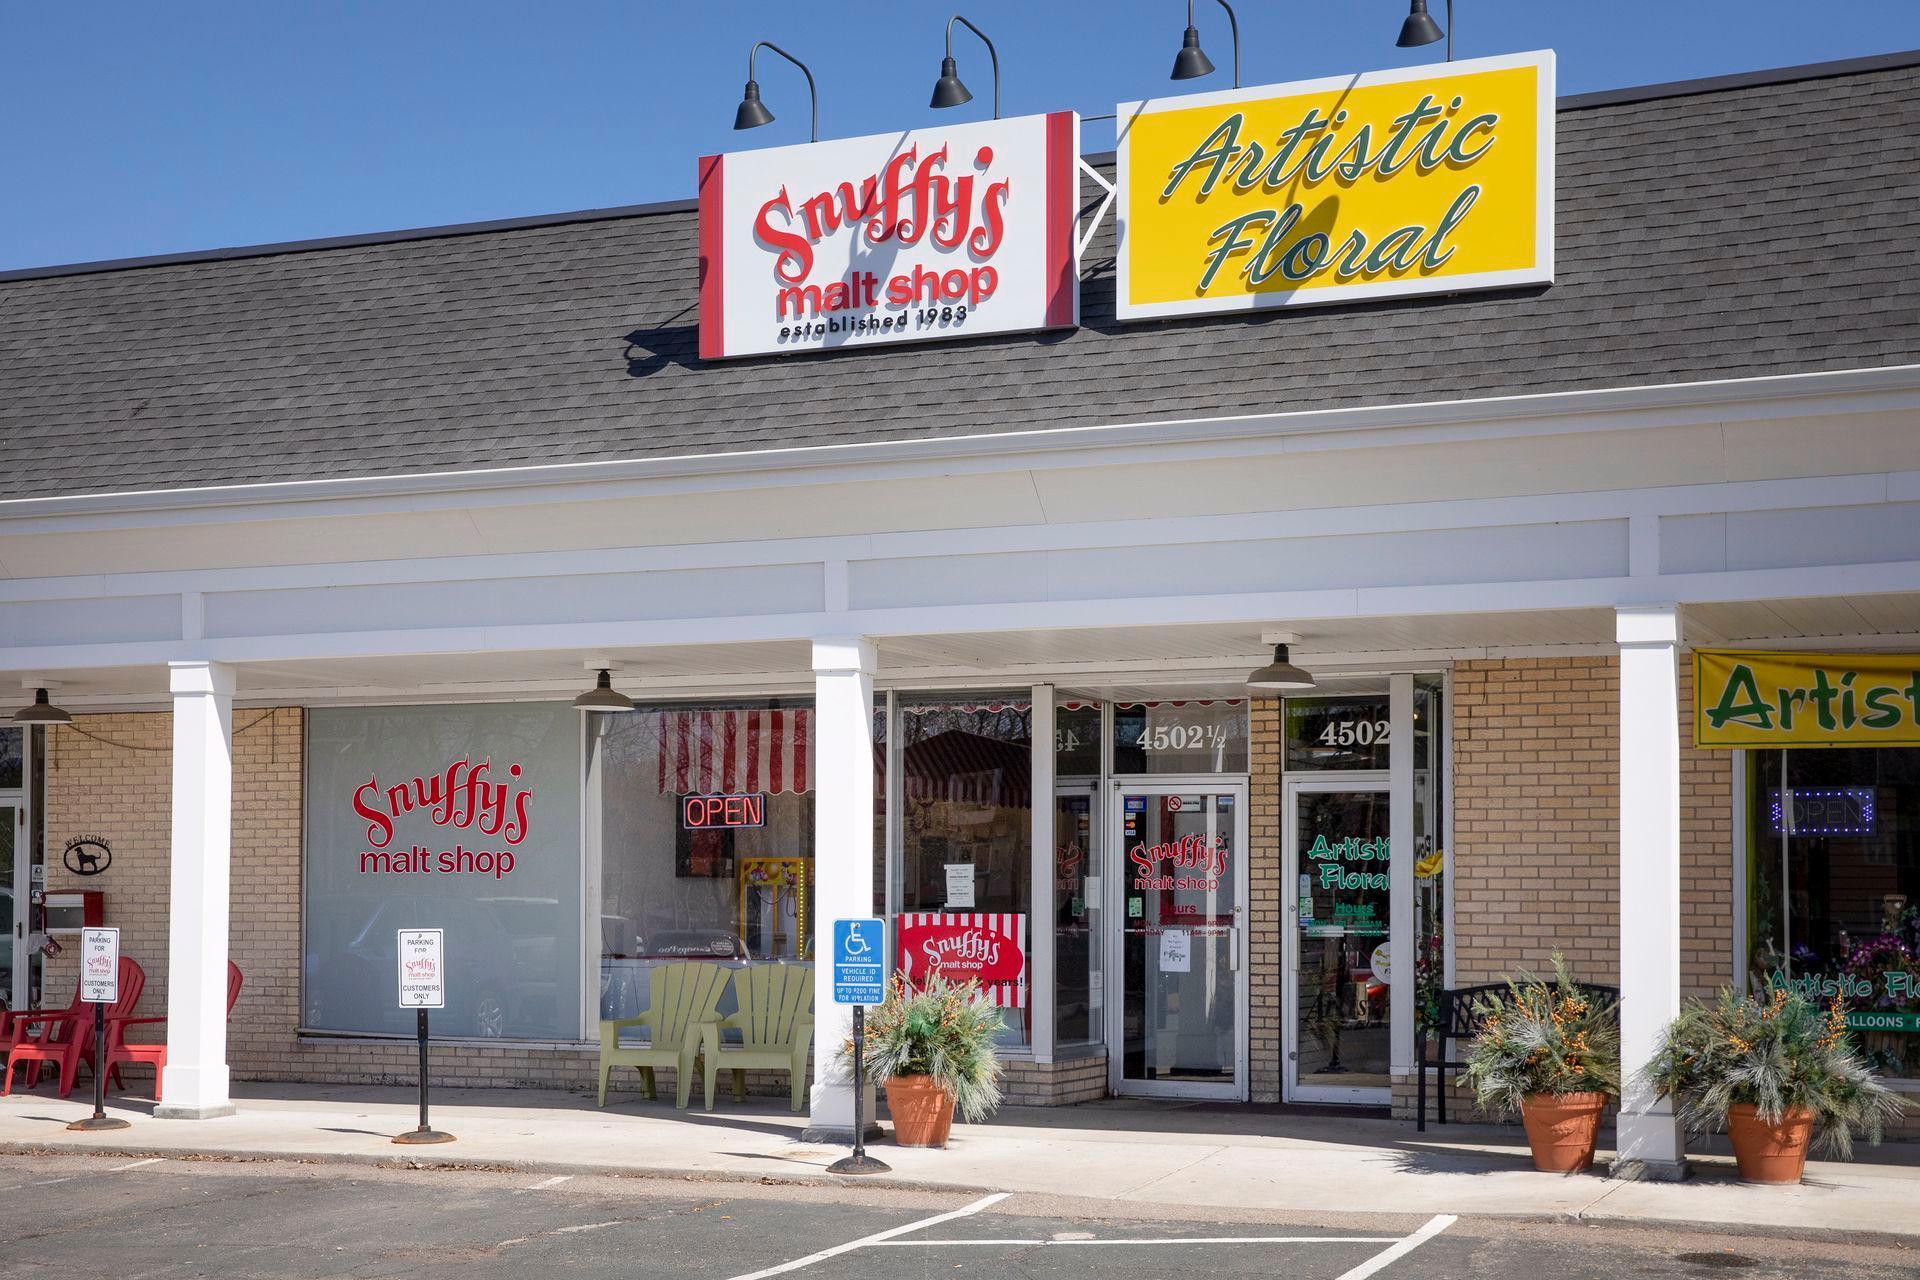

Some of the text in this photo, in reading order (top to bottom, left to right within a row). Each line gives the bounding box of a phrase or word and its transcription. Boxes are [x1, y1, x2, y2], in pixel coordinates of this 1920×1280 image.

[1163, 95, 1498, 198] Artistic
[755, 141, 1009, 283] Snuffy's
[1200, 185, 1481, 290] Floral
[779, 264, 998, 316] malt shop
[780, 305, 968, 338] established 1983
[1319, 720, 1390, 746] 4502
[352, 752, 533, 848] Snuffy's
[686, 797, 761, 826] OPEN
[65, 834, 110, 849] WELCOME
[1130, 832, 1228, 878] Snuffy's
[1308, 834, 1390, 861] Artisti
[359, 845, 515, 880] malt shop
[1134, 875, 1220, 892] malt shop
[1170, 905, 1196, 913] ours
[1335, 902, 1374, 914] Hours
[922, 928, 1001, 966] Snuffy's
[941, 960, 983, 970] malt shop
[92, 987, 106, 995] ONLY
[402, 984, 440, 992] CUSTOMERS
[413, 992, 430, 1000] ONLY
[987, 977, 1023, 988] years!
[1765, 969, 1920, 998] Artistic Fl
[1842, 1016, 1903, 1028] ALLOONS
